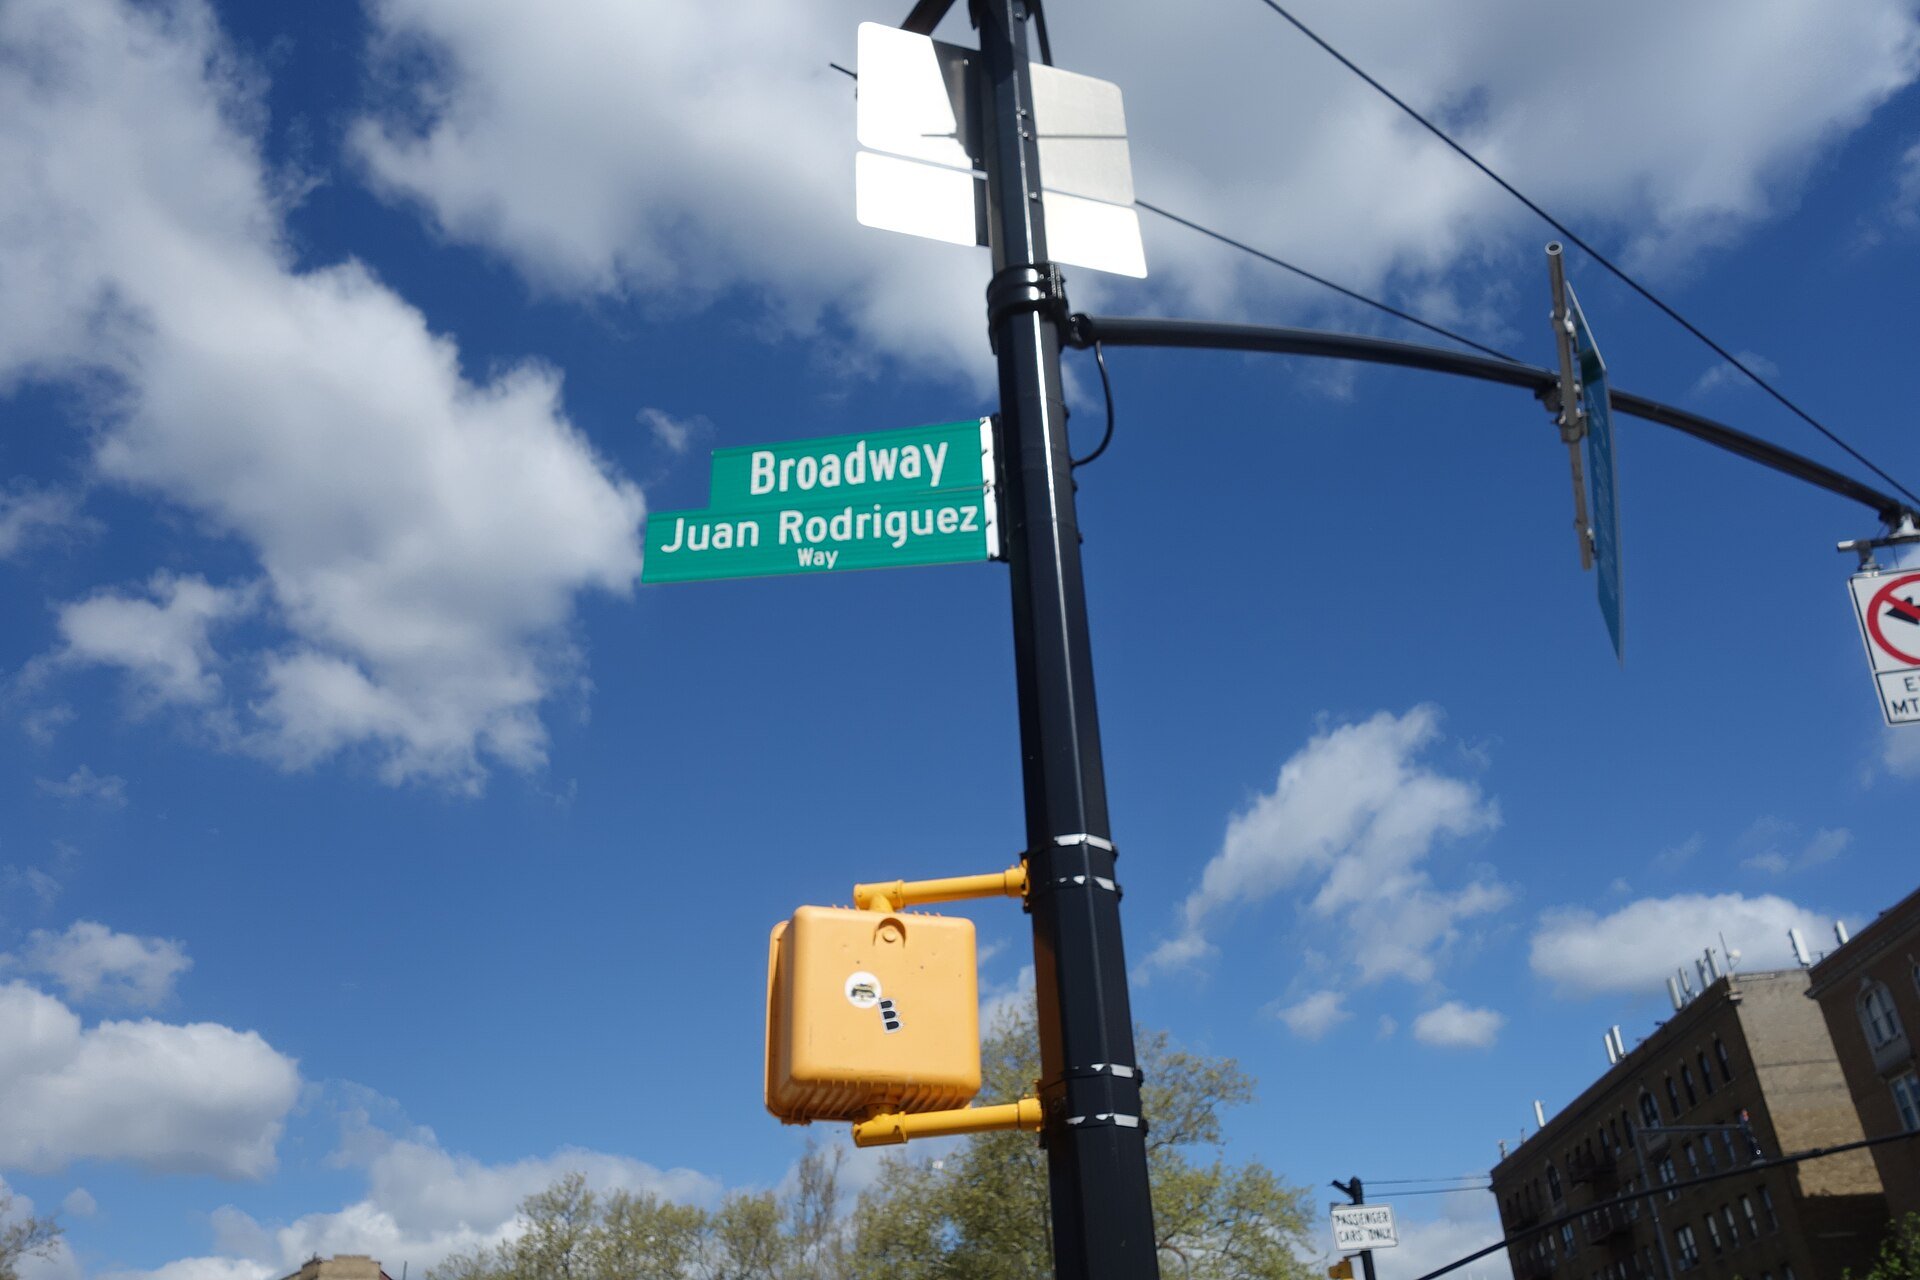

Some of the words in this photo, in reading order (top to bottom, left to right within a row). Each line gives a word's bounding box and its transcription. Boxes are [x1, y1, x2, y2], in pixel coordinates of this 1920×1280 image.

[750, 440, 949, 495] Broadway
[660, 517, 760, 553] Juan
[778, 504, 979, 549] Rodriguez
[797, 547, 839, 569] Way
[1903, 676, 1920, 692] E
[1333, 1211, 1388, 1226] PASSENGER
